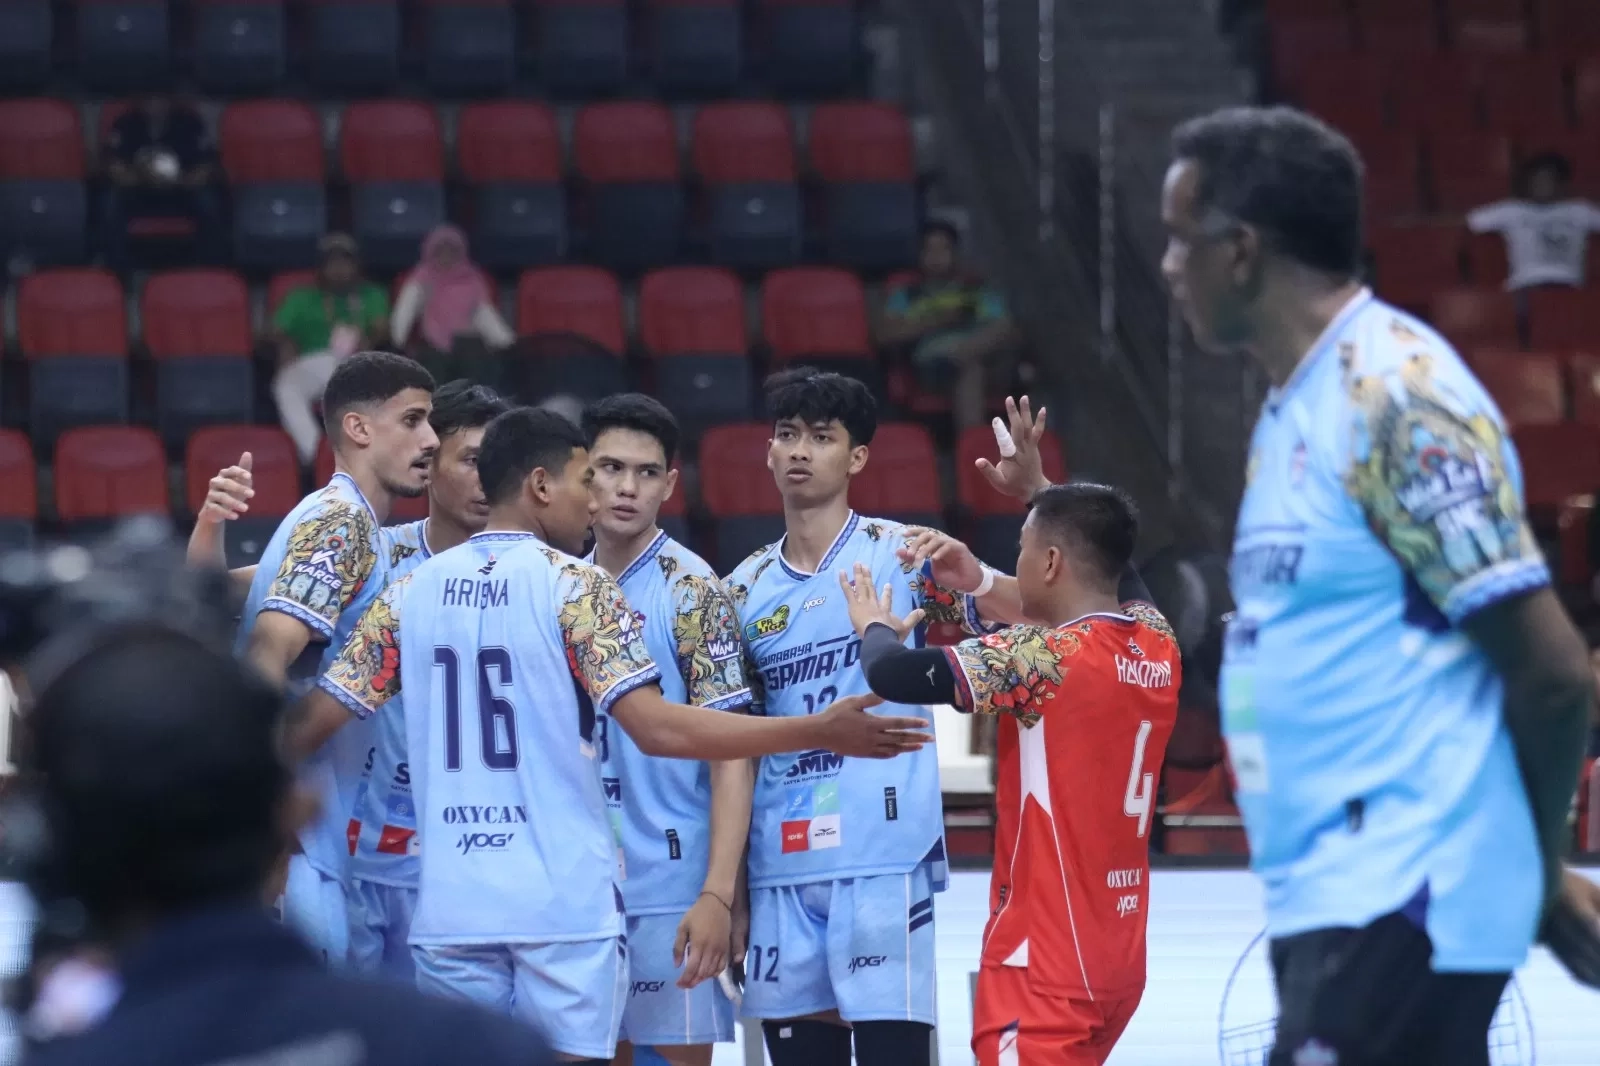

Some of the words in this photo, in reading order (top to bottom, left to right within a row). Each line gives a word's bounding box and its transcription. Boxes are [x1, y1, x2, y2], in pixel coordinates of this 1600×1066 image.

[293, 563, 342, 590] KARGE
[442, 577, 509, 610] KRISNA
[708, 641, 733, 657] WANI
[760, 642, 813, 667] SURABAYA
[432, 644, 521, 773] 16
[1123, 720, 1153, 838] 4
[442, 805, 528, 824] OXYCAN
[752, 944, 779, 982] 12
